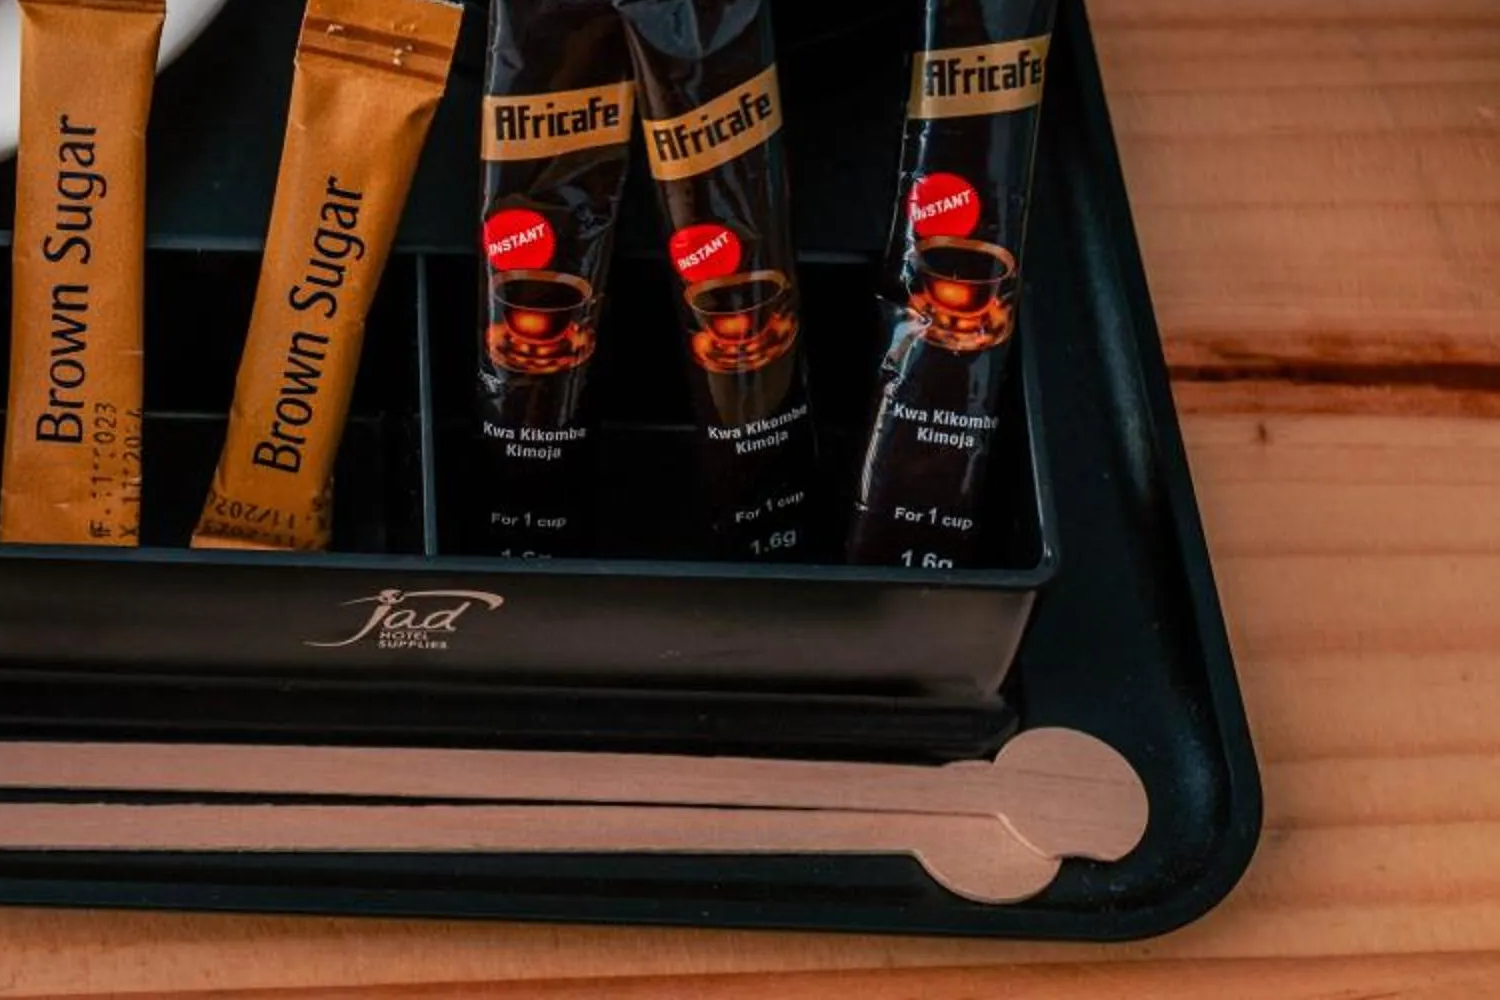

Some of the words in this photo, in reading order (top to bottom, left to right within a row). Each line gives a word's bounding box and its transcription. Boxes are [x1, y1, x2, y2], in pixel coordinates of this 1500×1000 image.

[494, 96, 619, 141] Africafe
[653, 92, 774, 162] Africafe
[43, 114, 107, 265] Sugar
[910, 189, 972, 222] INSTANT
[288, 175, 365, 318] Sugar
[488, 223, 547, 255] INSTANT
[677, 230, 730, 270] INSTANT
[35, 283, 90, 445] Brown
[253, 330, 330, 474] Brown
[893, 402, 928, 423] Kwa
[483, 420, 515, 440] Kwa
[707, 425, 742, 440] Kwa
[735, 430, 789, 455] Kimoja
[916, 426, 975, 450] Kimoja
[506, 443, 562, 461] Kimoja
[490, 511, 519, 527] For
[524, 512, 531, 527] 1
[537, 516, 567, 529] cup
[735, 508, 761, 523] For
[765, 497, 773, 512] 1
[777, 491, 805, 508] cup
[894, 507, 924, 523] For
[928, 508, 937, 525] 1
[942, 515, 973, 531] cup
[750, 528, 797, 555] 1.6g
[303, 589, 504, 647] jad
[378, 639, 448, 650] SUPPLIES
[379, 630, 429, 640] HOTEL
